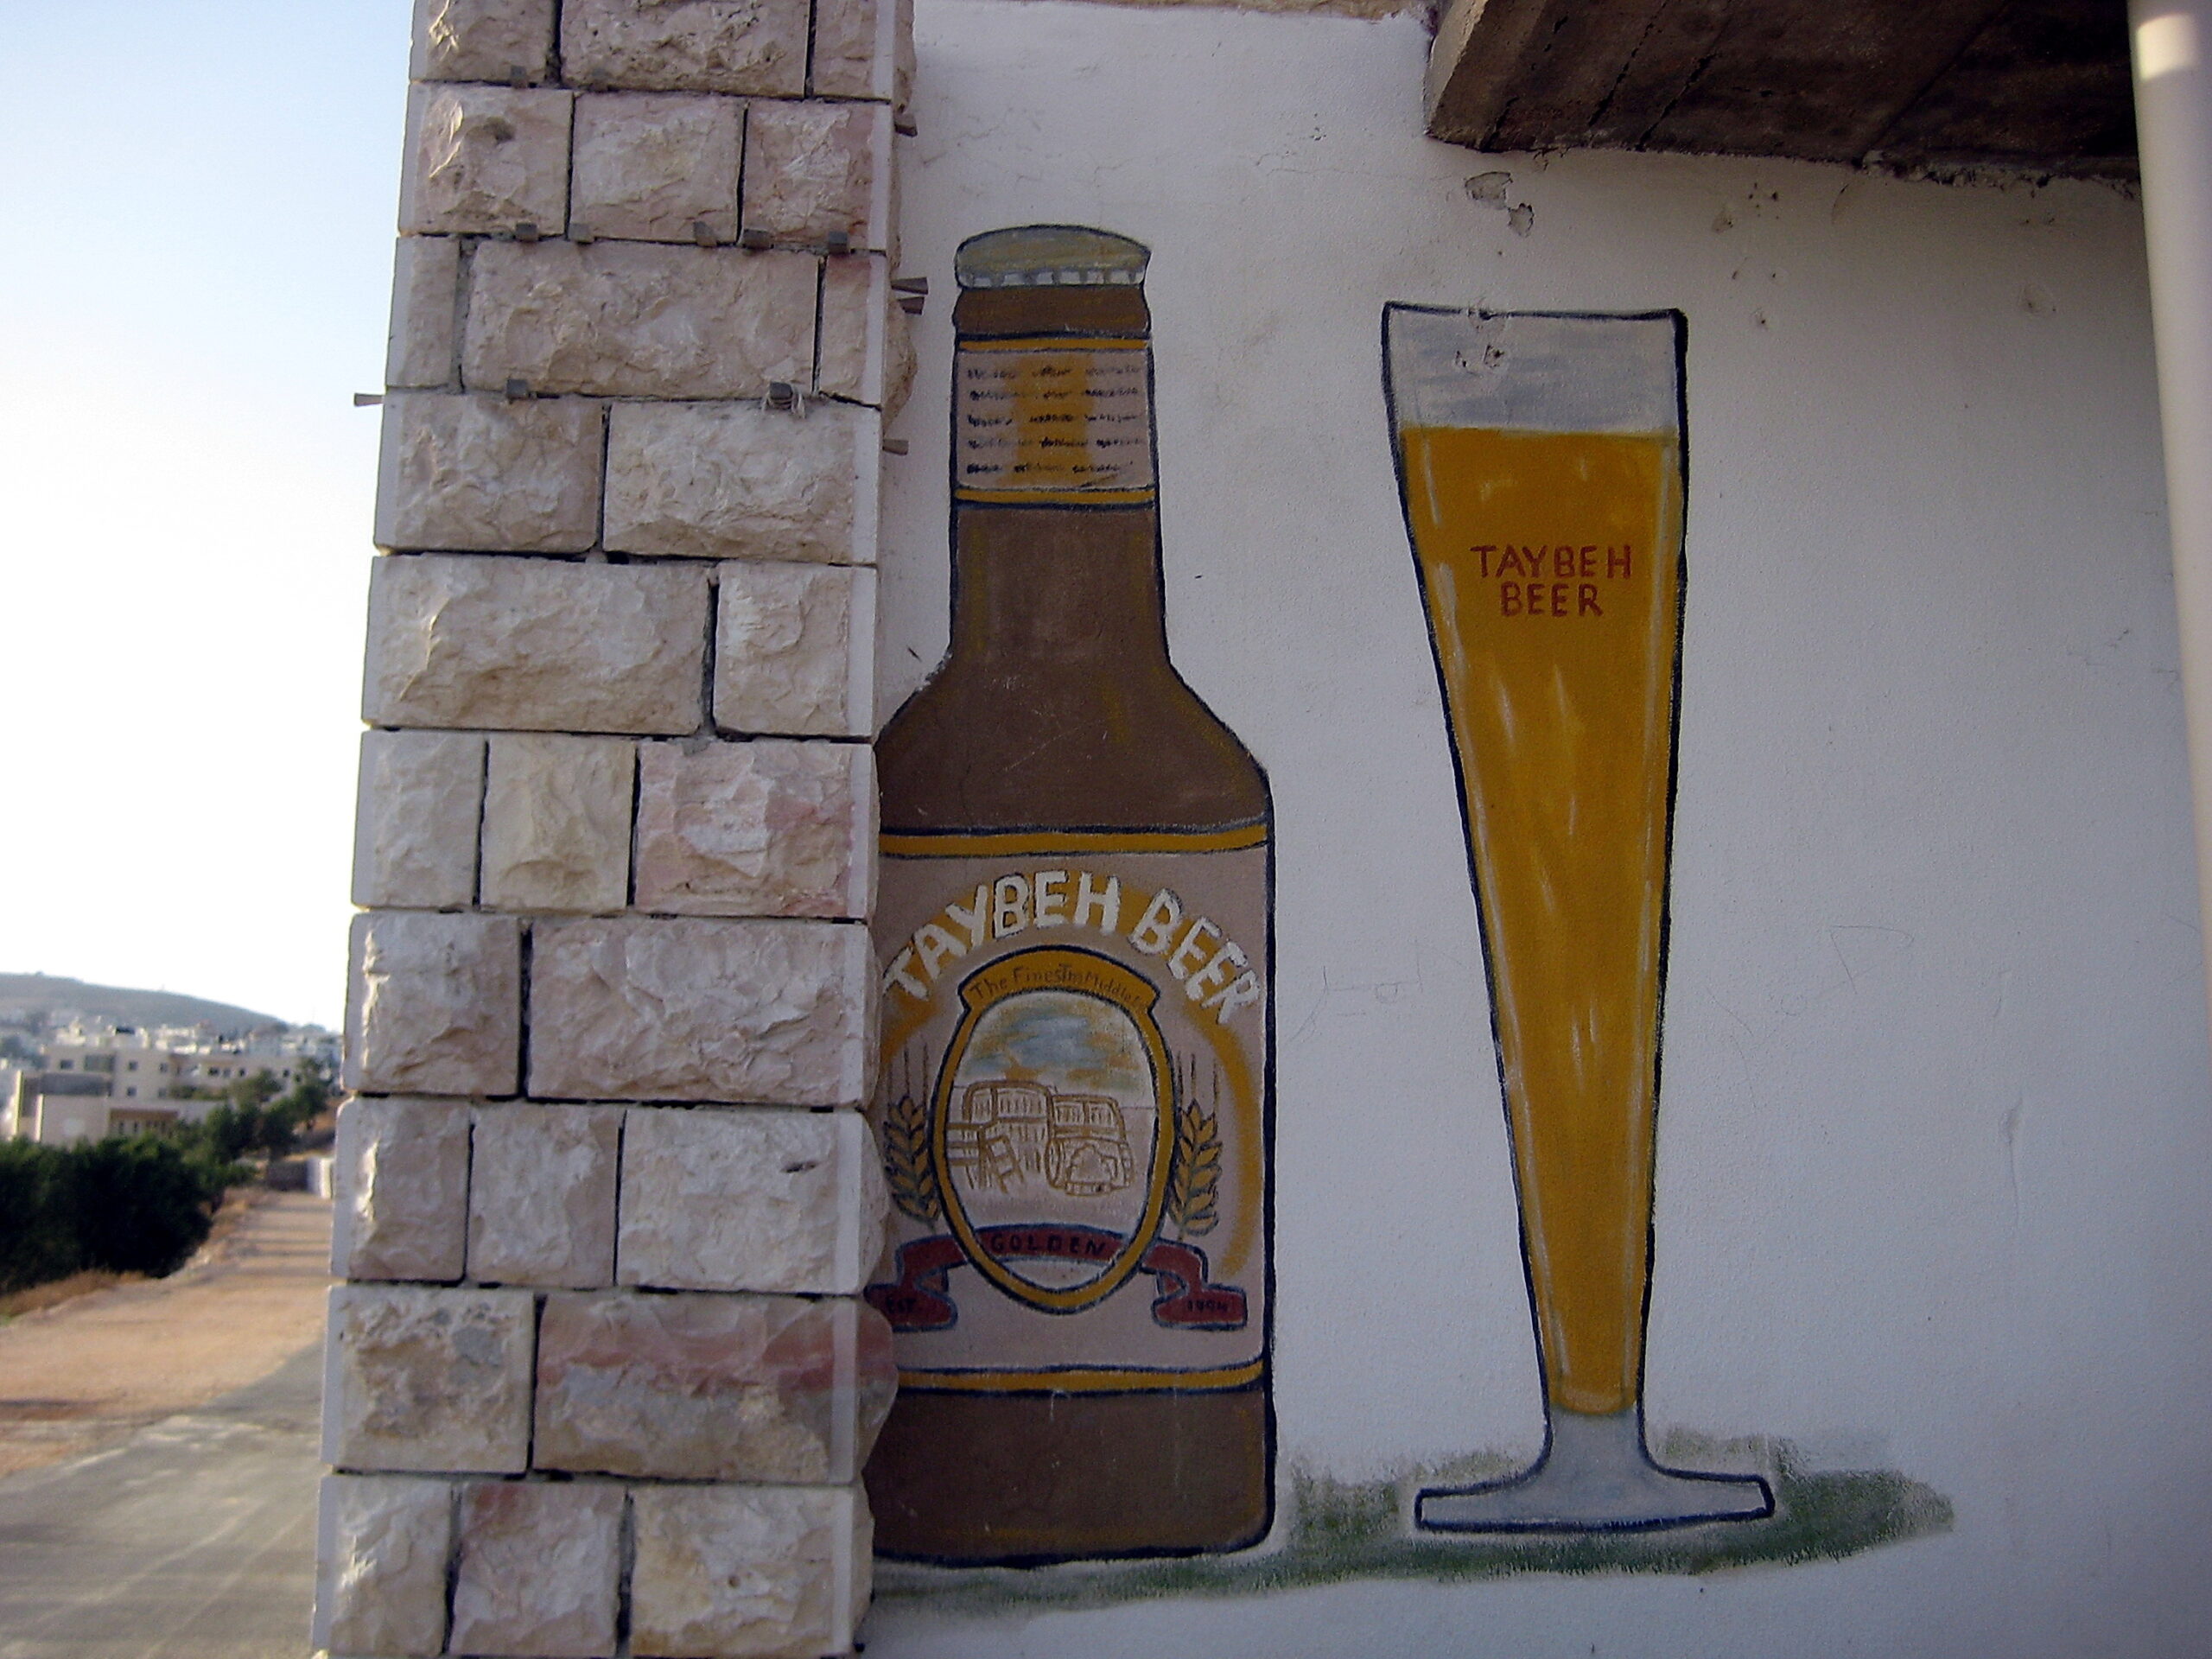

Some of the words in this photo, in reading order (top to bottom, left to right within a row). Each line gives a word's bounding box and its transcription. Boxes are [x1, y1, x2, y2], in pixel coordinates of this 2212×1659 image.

[1470, 543, 1631, 580] TAYBEH
[1500, 581, 1603, 618] BEER
[882, 869, 1121, 1001] TAYBEH
[1127, 887, 1261, 1025] BEER
[969, 977, 1008, 999] The
[990, 1232, 1107, 1256] GOLDEN
